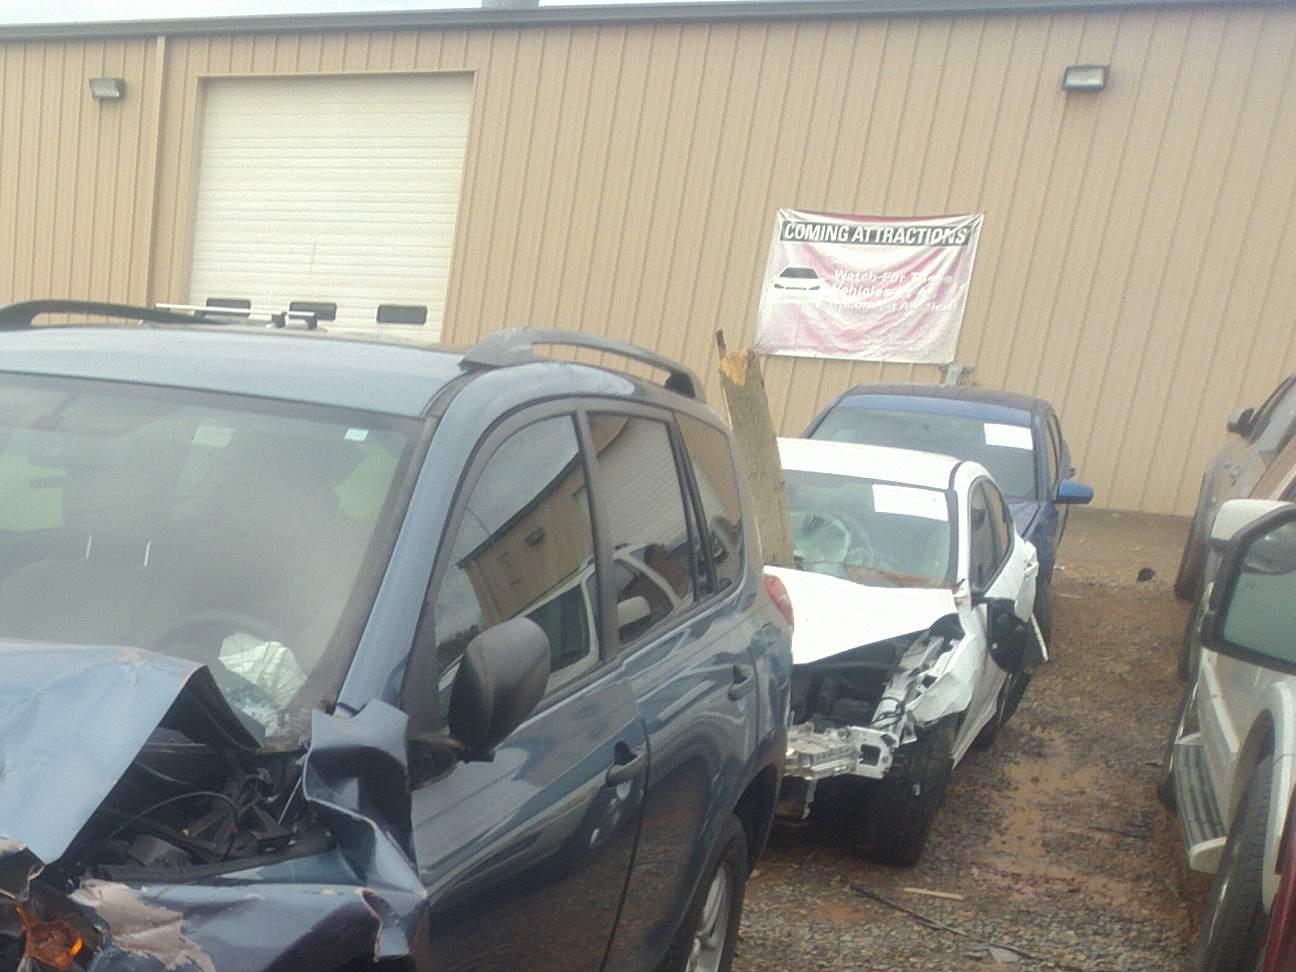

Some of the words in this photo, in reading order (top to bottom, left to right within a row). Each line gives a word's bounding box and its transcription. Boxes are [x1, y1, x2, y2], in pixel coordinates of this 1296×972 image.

[784, 222, 849, 242] COMING
[851, 226, 969, 245] ATTRACTIONS
[834, 270, 877, 282] Watch
